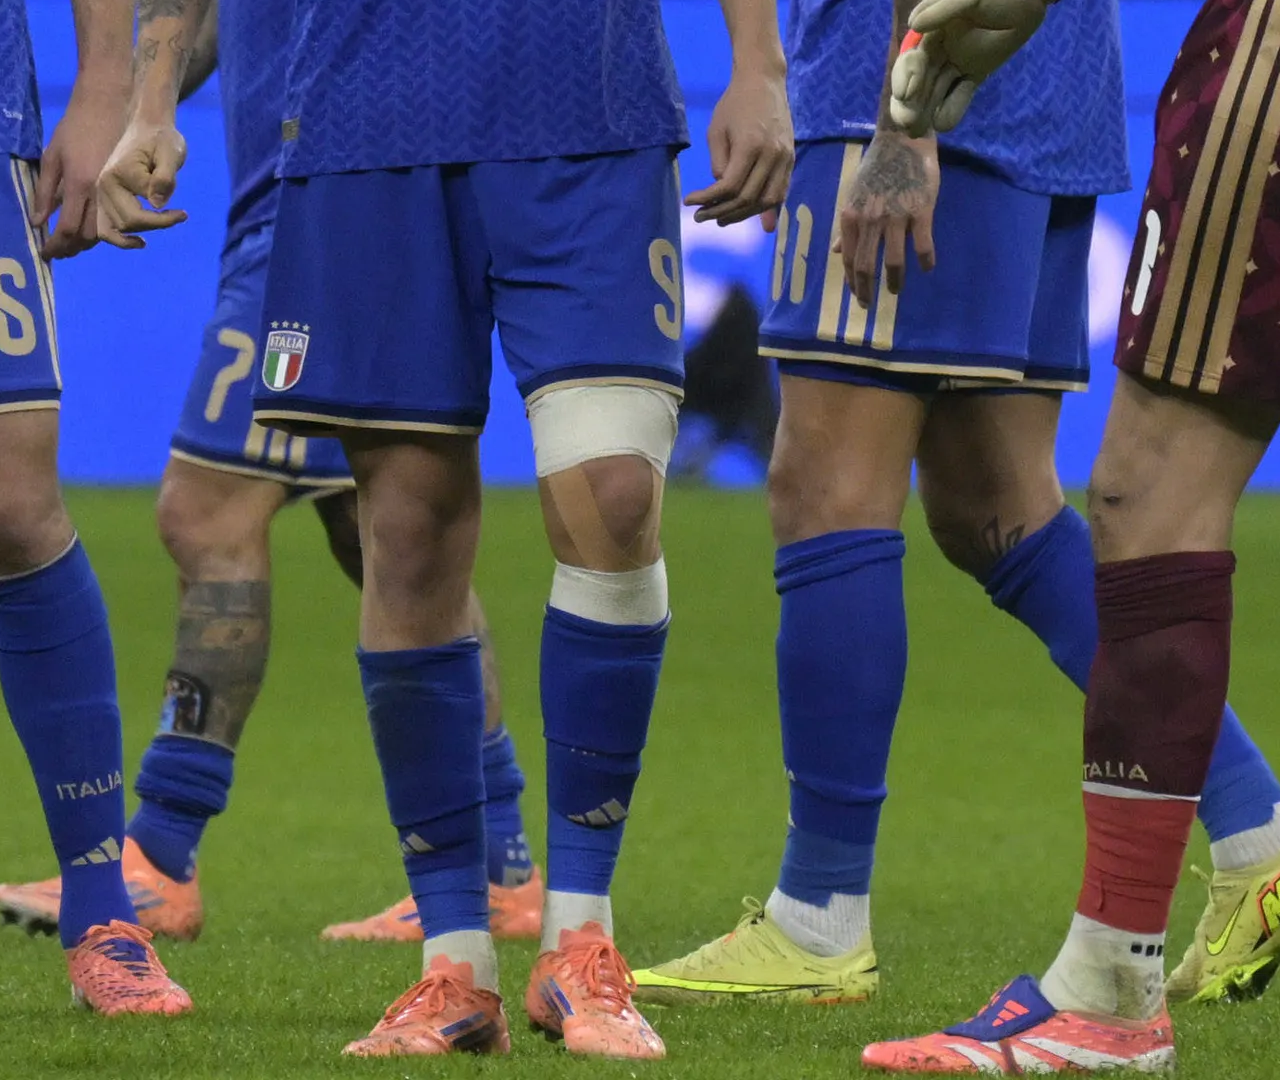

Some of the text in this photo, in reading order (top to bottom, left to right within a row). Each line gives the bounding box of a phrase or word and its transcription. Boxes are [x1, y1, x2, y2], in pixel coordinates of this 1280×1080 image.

[649, 238, 681, 341] 9
[1131, 209, 1161, 316] 1
[204, 328, 255, 423] 7
[270, 335, 304, 350] ITALIA
[56, 770, 122, 800] ITALIA
